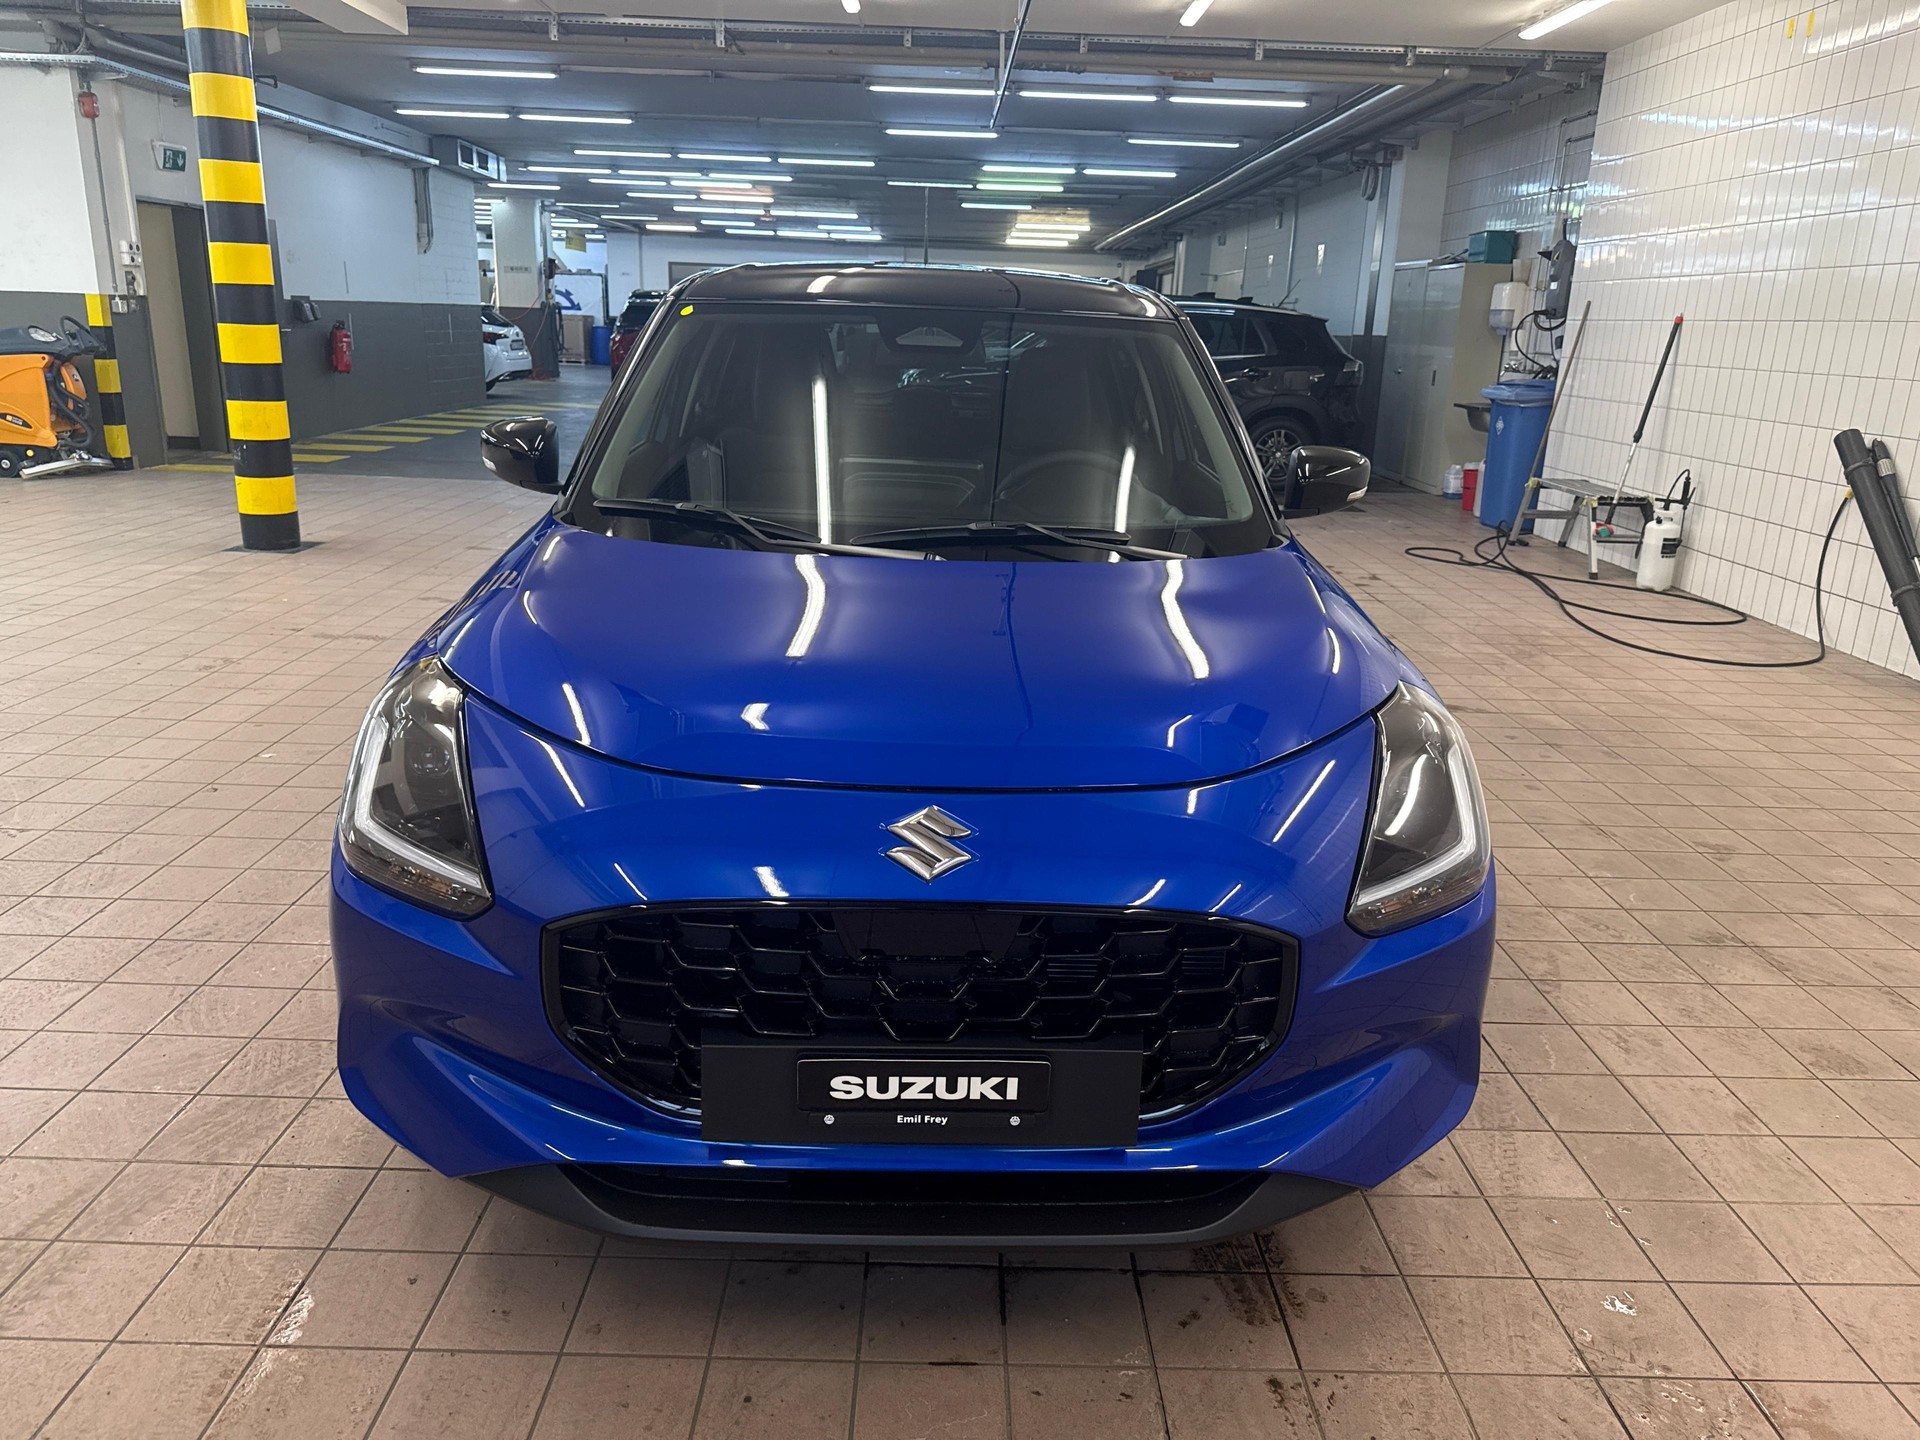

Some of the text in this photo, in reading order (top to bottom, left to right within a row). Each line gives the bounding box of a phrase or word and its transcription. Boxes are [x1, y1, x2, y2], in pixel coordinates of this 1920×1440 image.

[829, 1075, 1019, 1101] SUZUKI
[896, 1114, 948, 1126] Emil Frey
